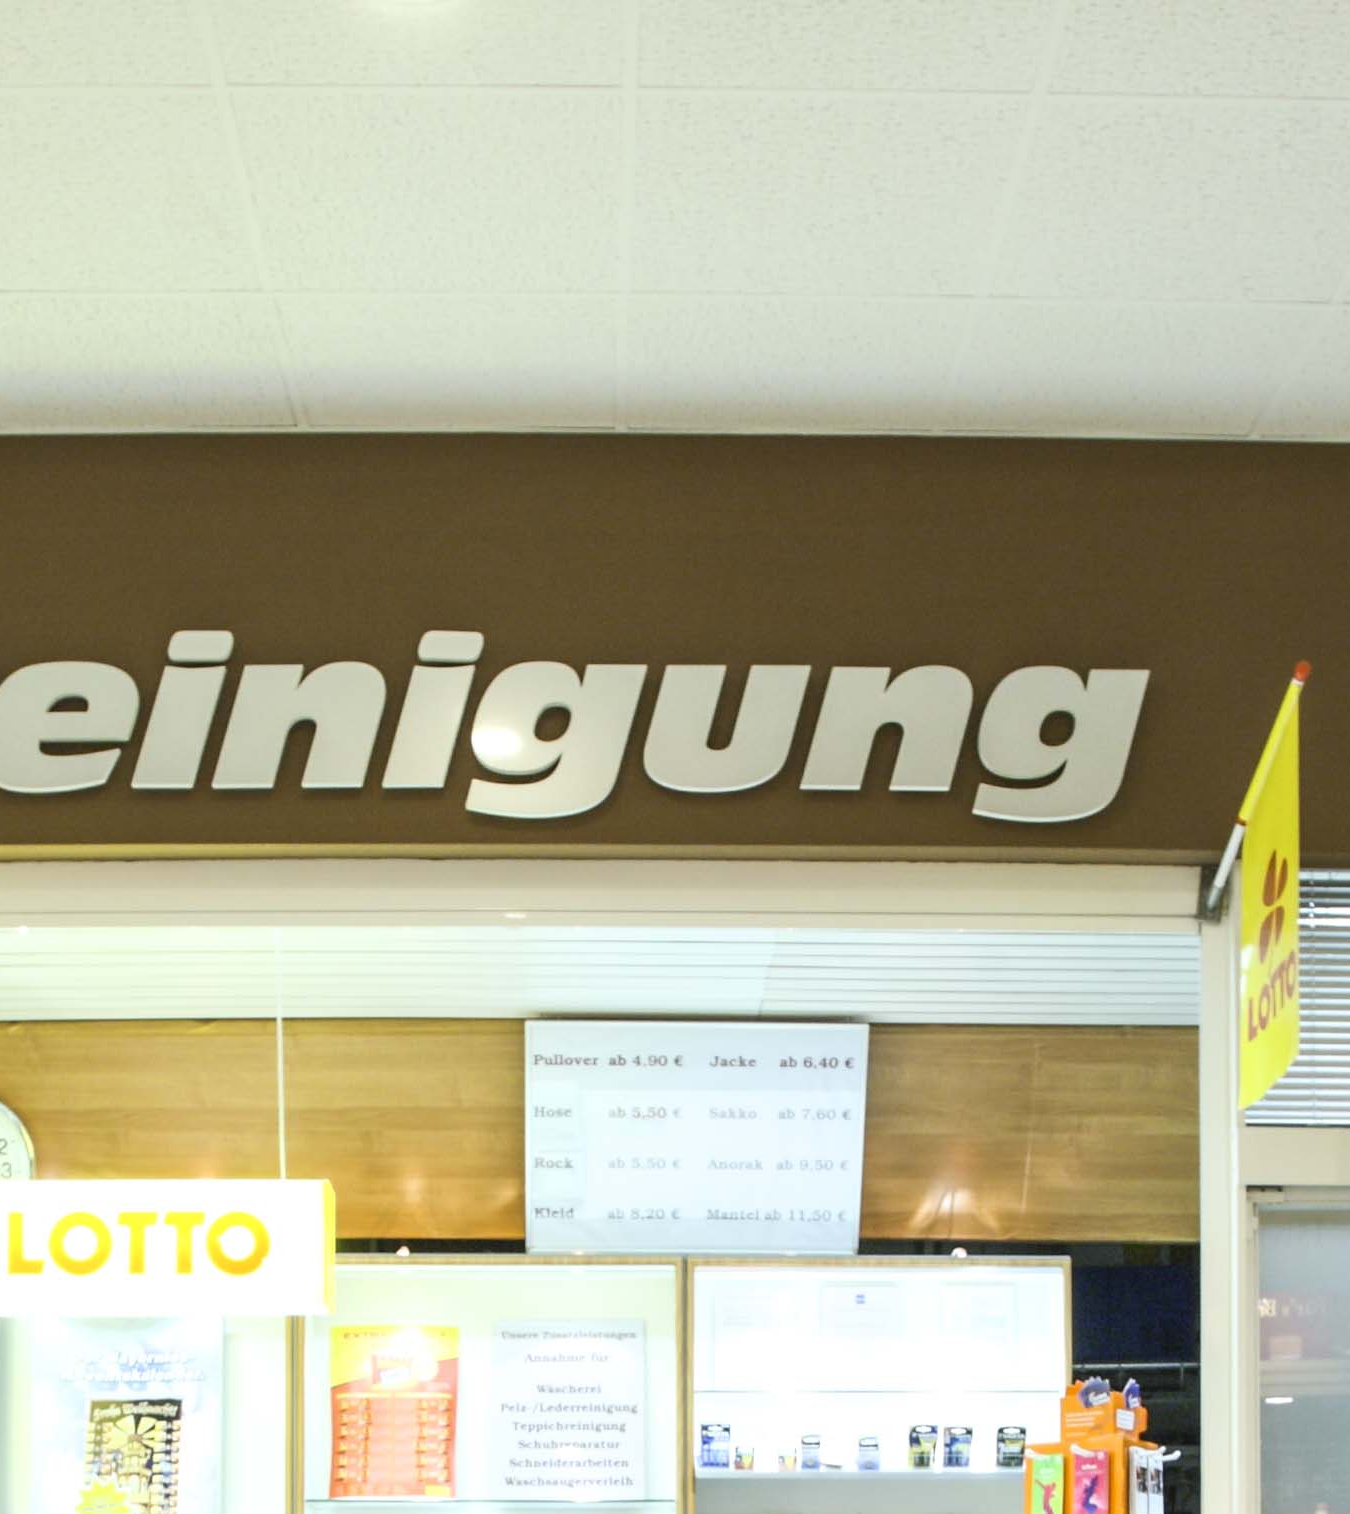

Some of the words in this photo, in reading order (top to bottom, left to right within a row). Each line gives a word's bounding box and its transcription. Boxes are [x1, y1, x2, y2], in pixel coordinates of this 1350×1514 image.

[1248, 951, 1297, 1042] LOTTO
[532, 1053, 600, 1068] Pullover
[608, 1054, 628, 1067] ab
[673, 1055, 684, 1067] €
[708, 1055, 758, 1069] Jacke
[779, 1056, 798, 1069] ab
[844, 1057, 855, 1070] €
[533, 1106, 573, 1119] Hose
[608, 1106, 628, 1119] ab
[673, 1107, 684, 1119] €
[708, 1107, 758, 1120] Sakko
[777, 1107, 797, 1120] ab
[842, 1108, 852, 1121] €
[533, 1156, 575, 1169] Rock
[607, 1157, 627, 1170] ab
[672, 1157, 683, 1169] €
[706, 1158, 764, 1171] Anorak
[775, 1158, 794, 1171] ab
[840, 1159, 850, 1171] €
[0, 1162, 12, 1179] 3
[533, 1207, 576, 1220] Kleid
[607, 1207, 627, 1221] ab
[671, 1207, 682, 1220] €
[705, 1208, 761, 1221] Mantel
[764, 1208, 783, 1221] ab
[837, 1208, 848, 1222] €
[6, 1211, 271, 1277] LOTTO
[501, 1330, 540, 1340] Unsere
[524, 1352, 586, 1364] Annahme
[512, 1420, 628, 1434] Teppichreinigung
[508, 1458, 630, 1469] Schneiderarbeiten
